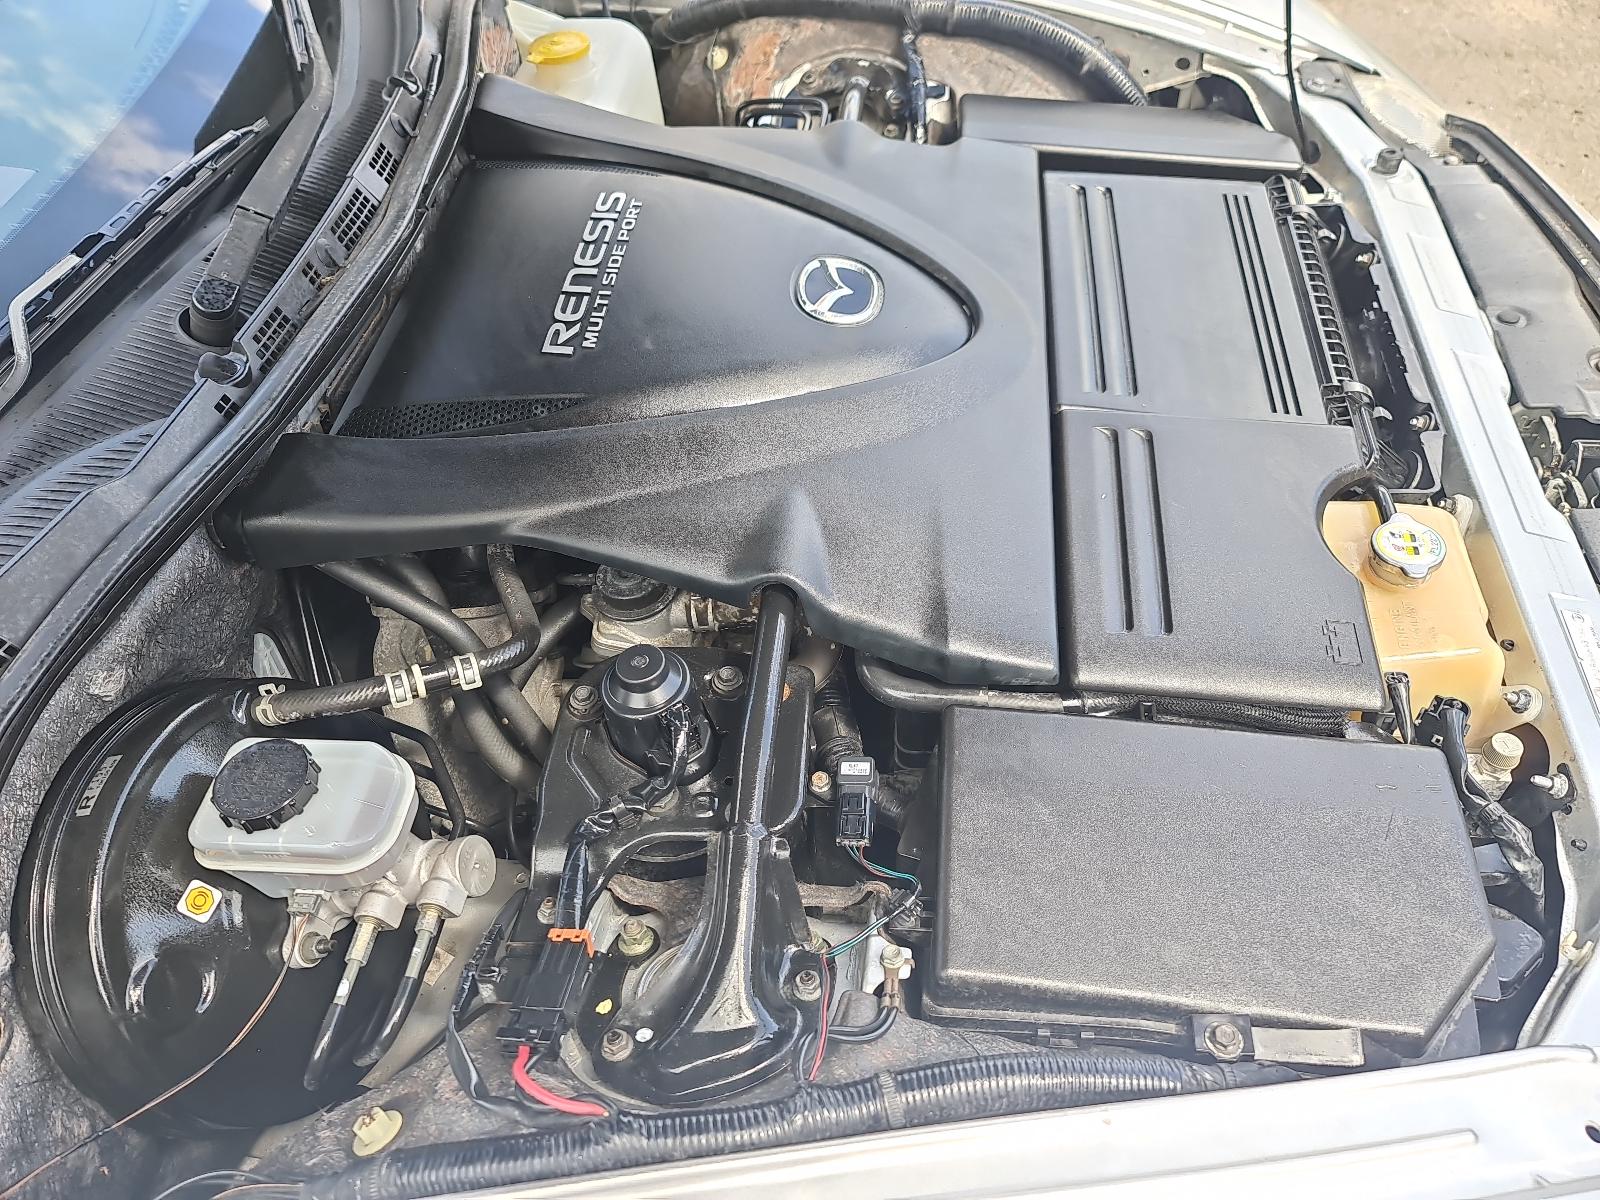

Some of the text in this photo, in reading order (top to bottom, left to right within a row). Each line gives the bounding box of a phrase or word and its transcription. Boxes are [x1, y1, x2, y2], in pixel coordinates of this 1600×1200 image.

[541, 191, 627, 355] RENESIS
[581, 197, 643, 348] MULTI SIDE PORT
